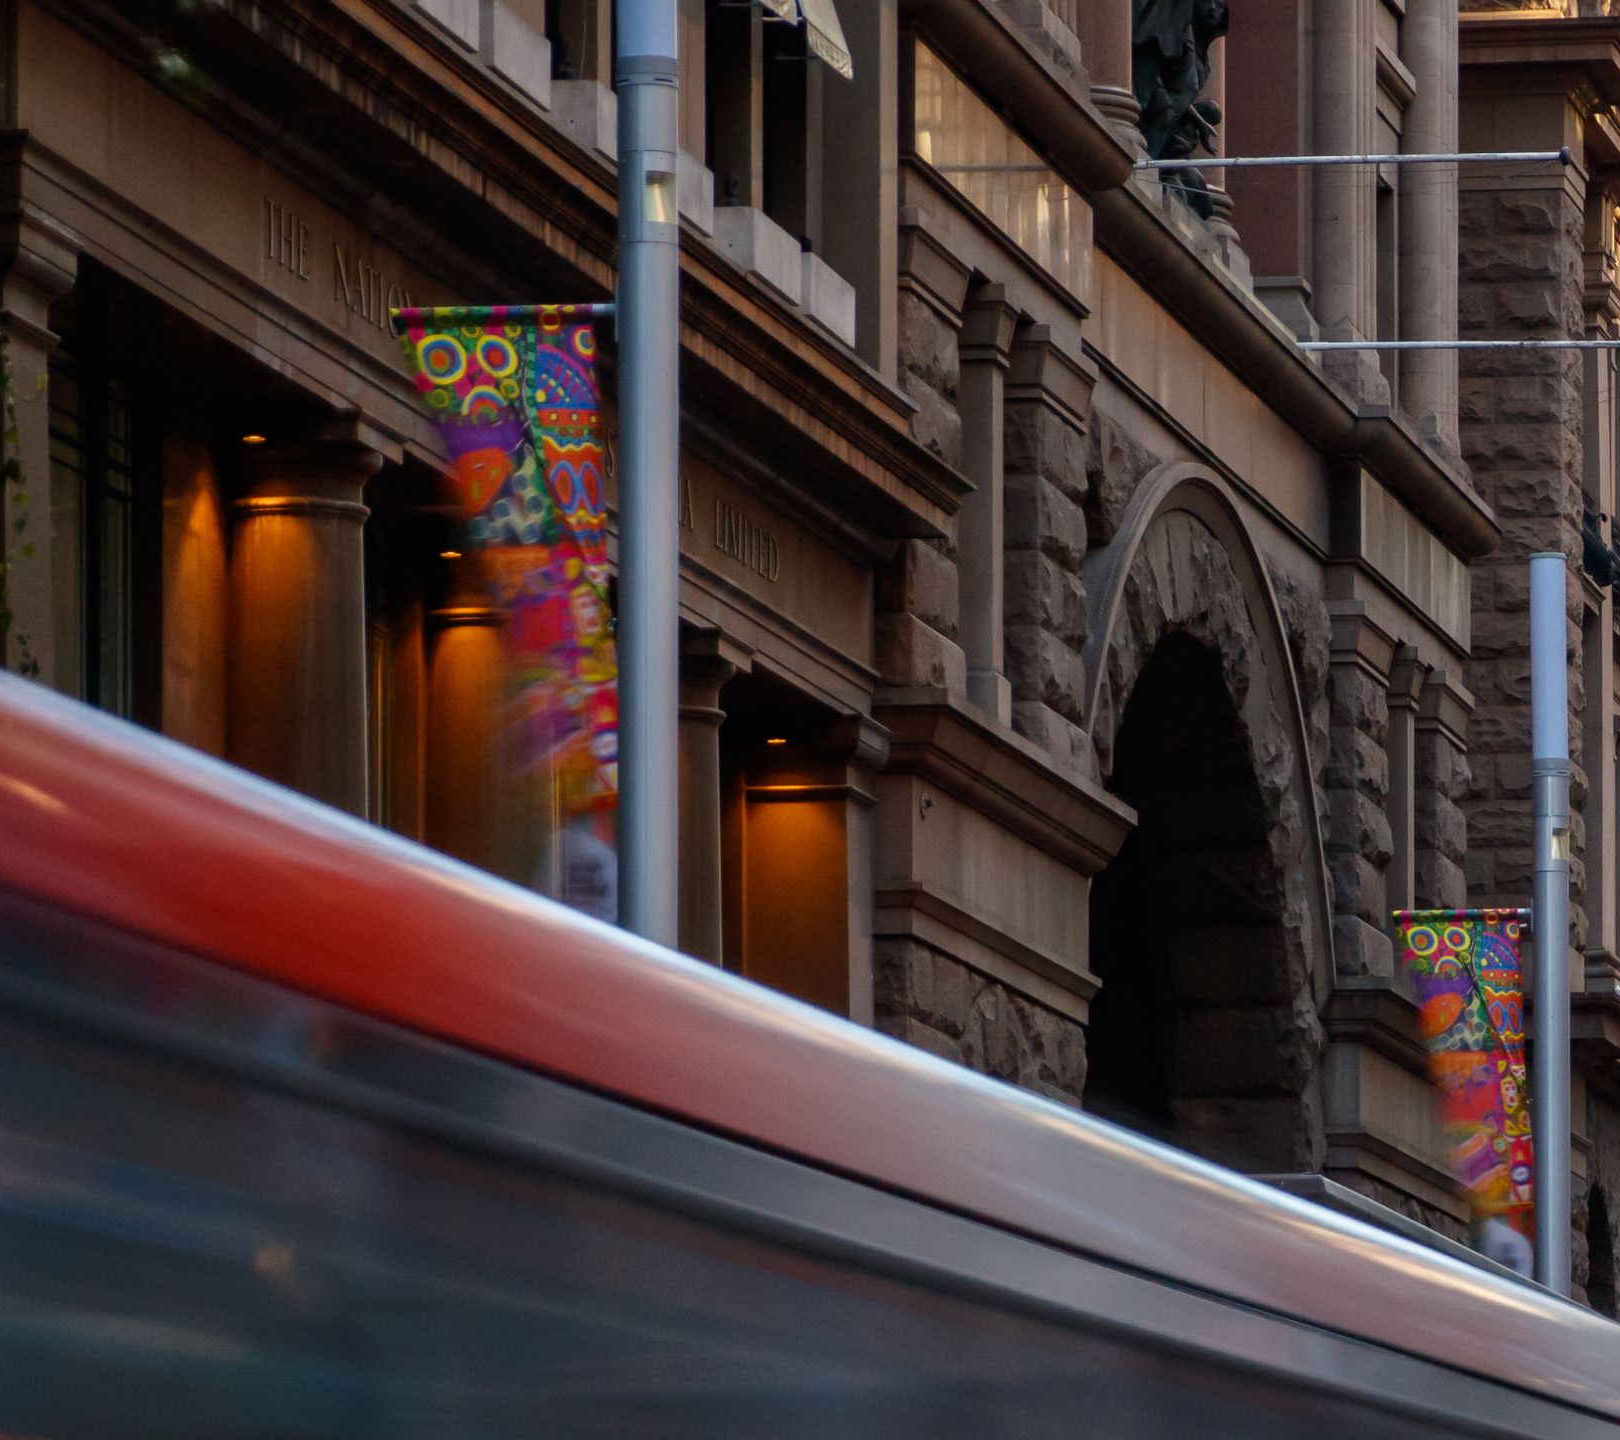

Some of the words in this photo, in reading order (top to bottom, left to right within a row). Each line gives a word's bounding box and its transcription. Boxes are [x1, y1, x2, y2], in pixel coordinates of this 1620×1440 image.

[265, 195, 310, 281] THE
[333, 239, 418, 338] NATIO
[715, 497, 780, 582] LIMITED
